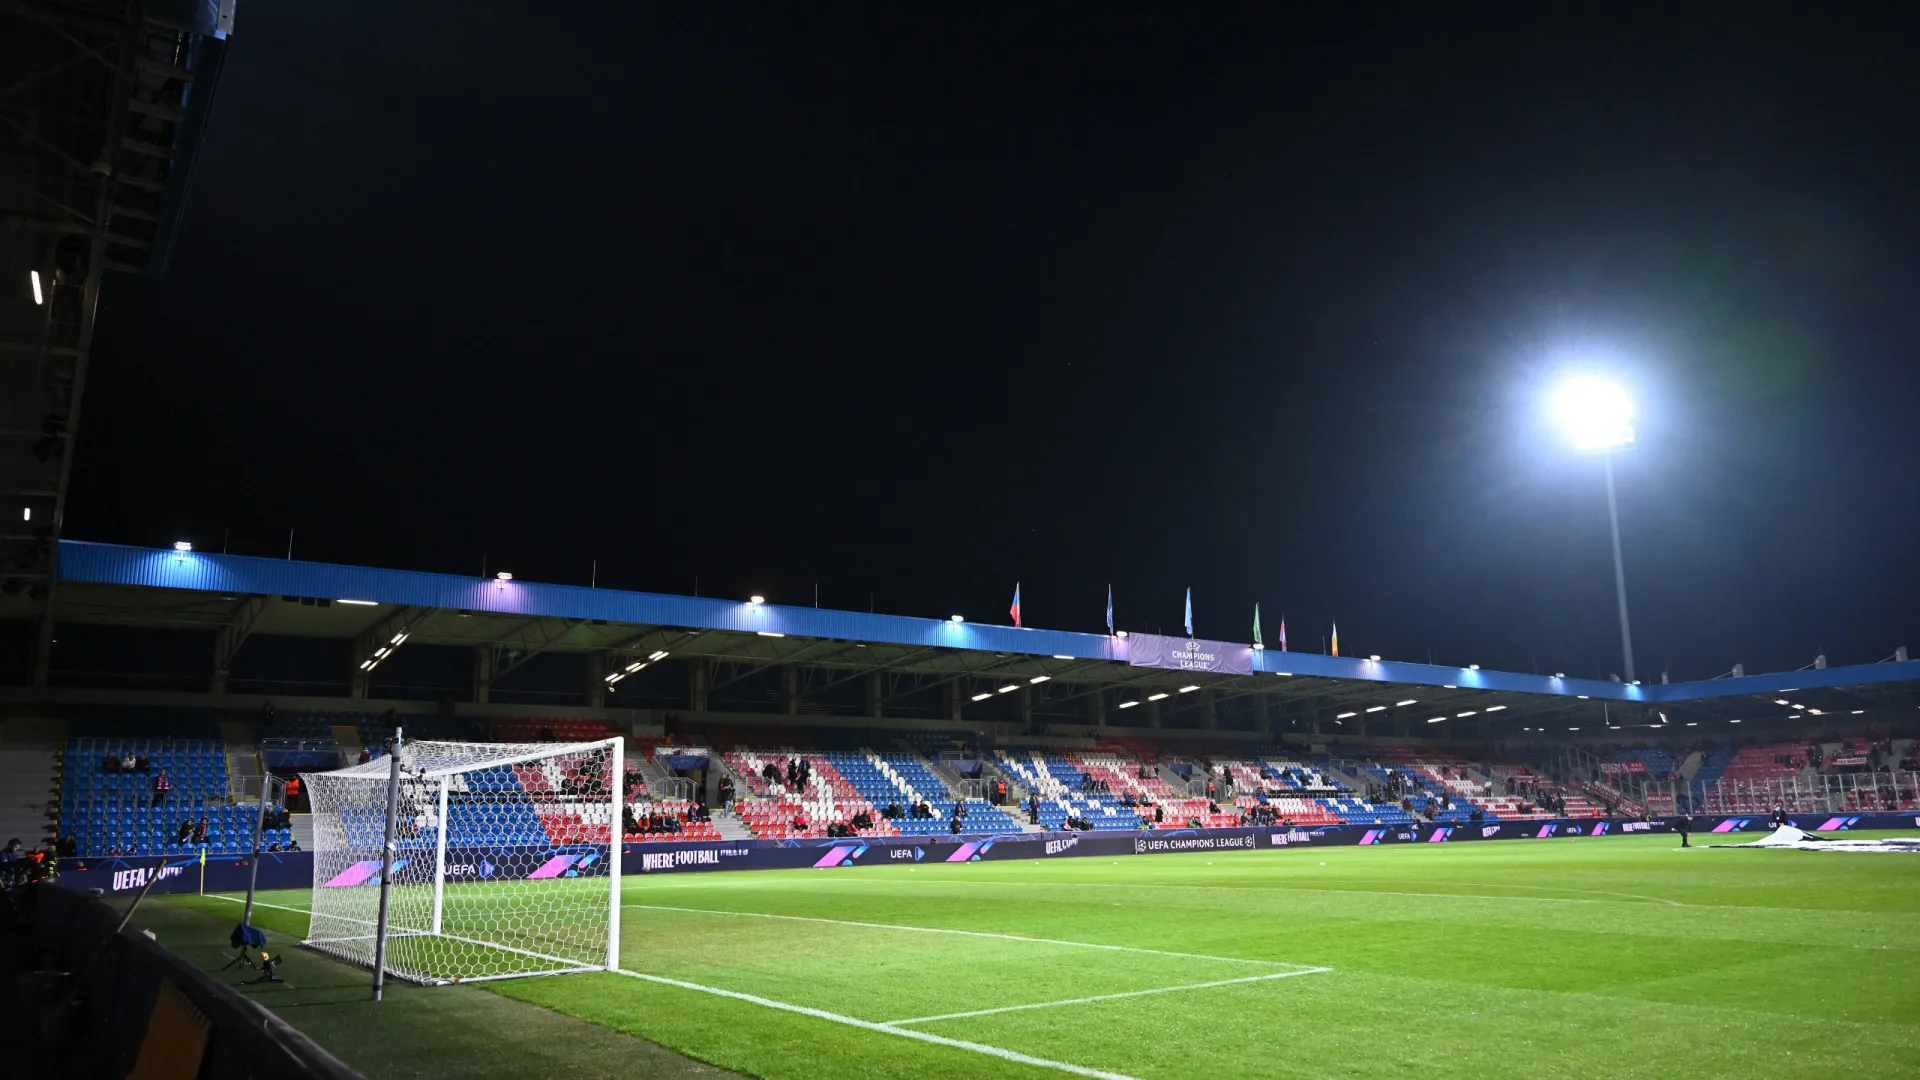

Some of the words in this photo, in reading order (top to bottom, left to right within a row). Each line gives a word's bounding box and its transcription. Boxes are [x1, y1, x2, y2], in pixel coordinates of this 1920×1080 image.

[1172, 650, 1215, 661] CHAMPIONS
[1180, 660, 1208, 669] LEAGUE
[1148, 840, 1169, 850] UEFA
[1170, 838, 1215, 849] CHAMPIONS
[1216, 837, 1244, 847] LEAGUE
[890, 849, 912, 858] UEFA
[642, 853, 674, 870] WHERE
[675, 849, 719, 865] FOOTBALL
[443, 864, 476, 875] UEFA
